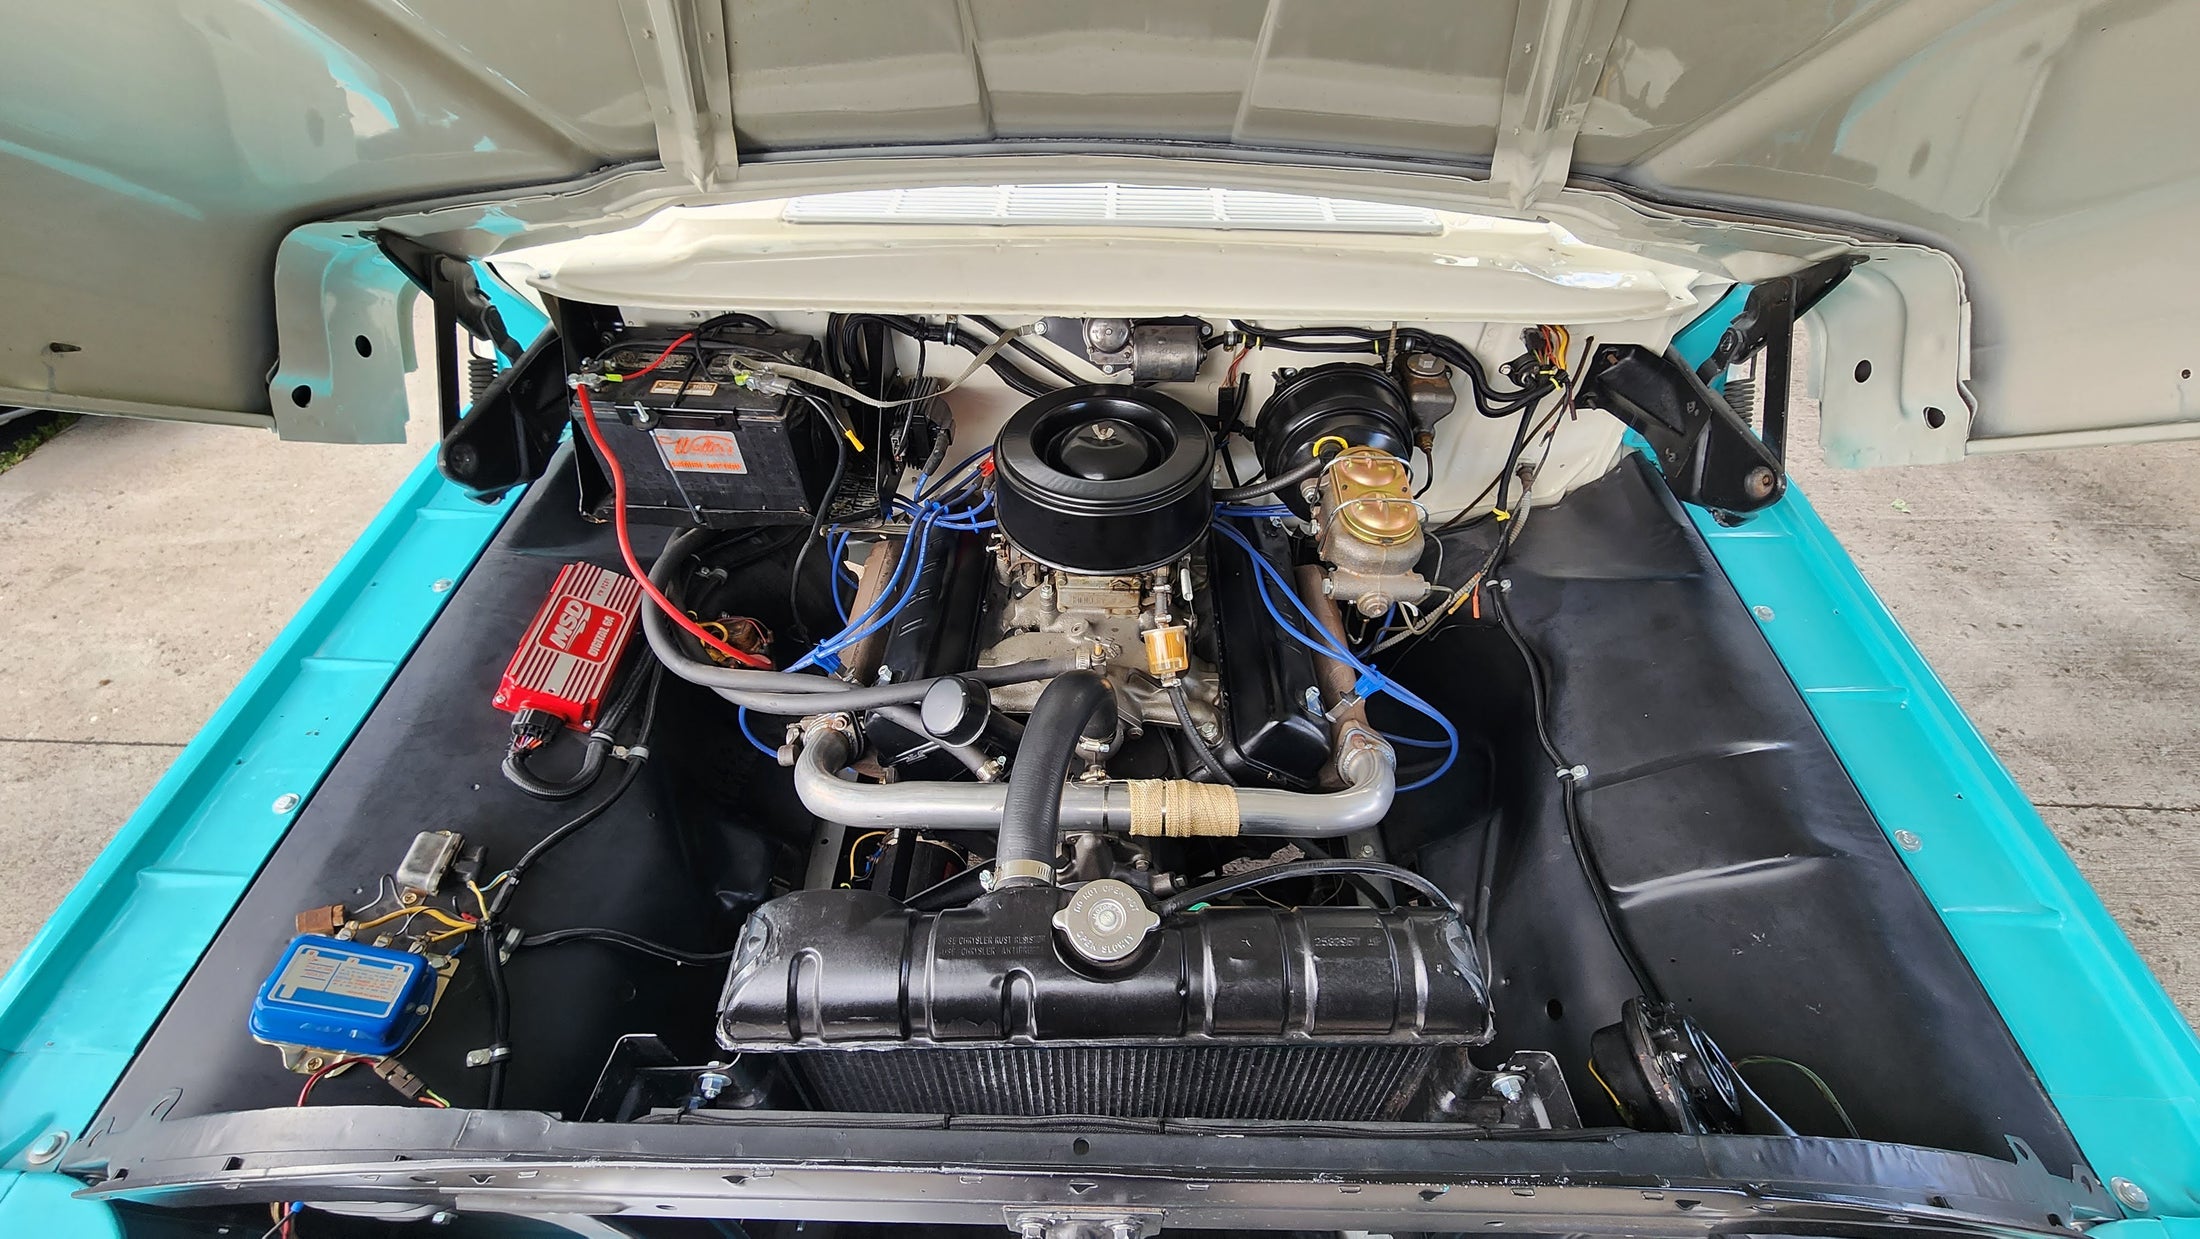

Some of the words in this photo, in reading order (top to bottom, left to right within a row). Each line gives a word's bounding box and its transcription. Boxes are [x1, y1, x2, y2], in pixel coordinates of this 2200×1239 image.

[548, 600, 585, 650] MSD
[587, 627, 610, 657] DIGITAL
[1073, 899, 1083, 913] DO
[1082, 887, 1098, 901] NOT
[1102, 885, 1126, 898] OPEN
[1126, 896, 1140, 912] HOT
[958, 935, 993, 945] CHRYSLER
[994, 935, 1012, 945] RUST
[960, 946, 996, 956] CHRYSLER
[1076, 930, 1098, 951] OPEN
[1101, 933, 1135, 954] SLOWLY
